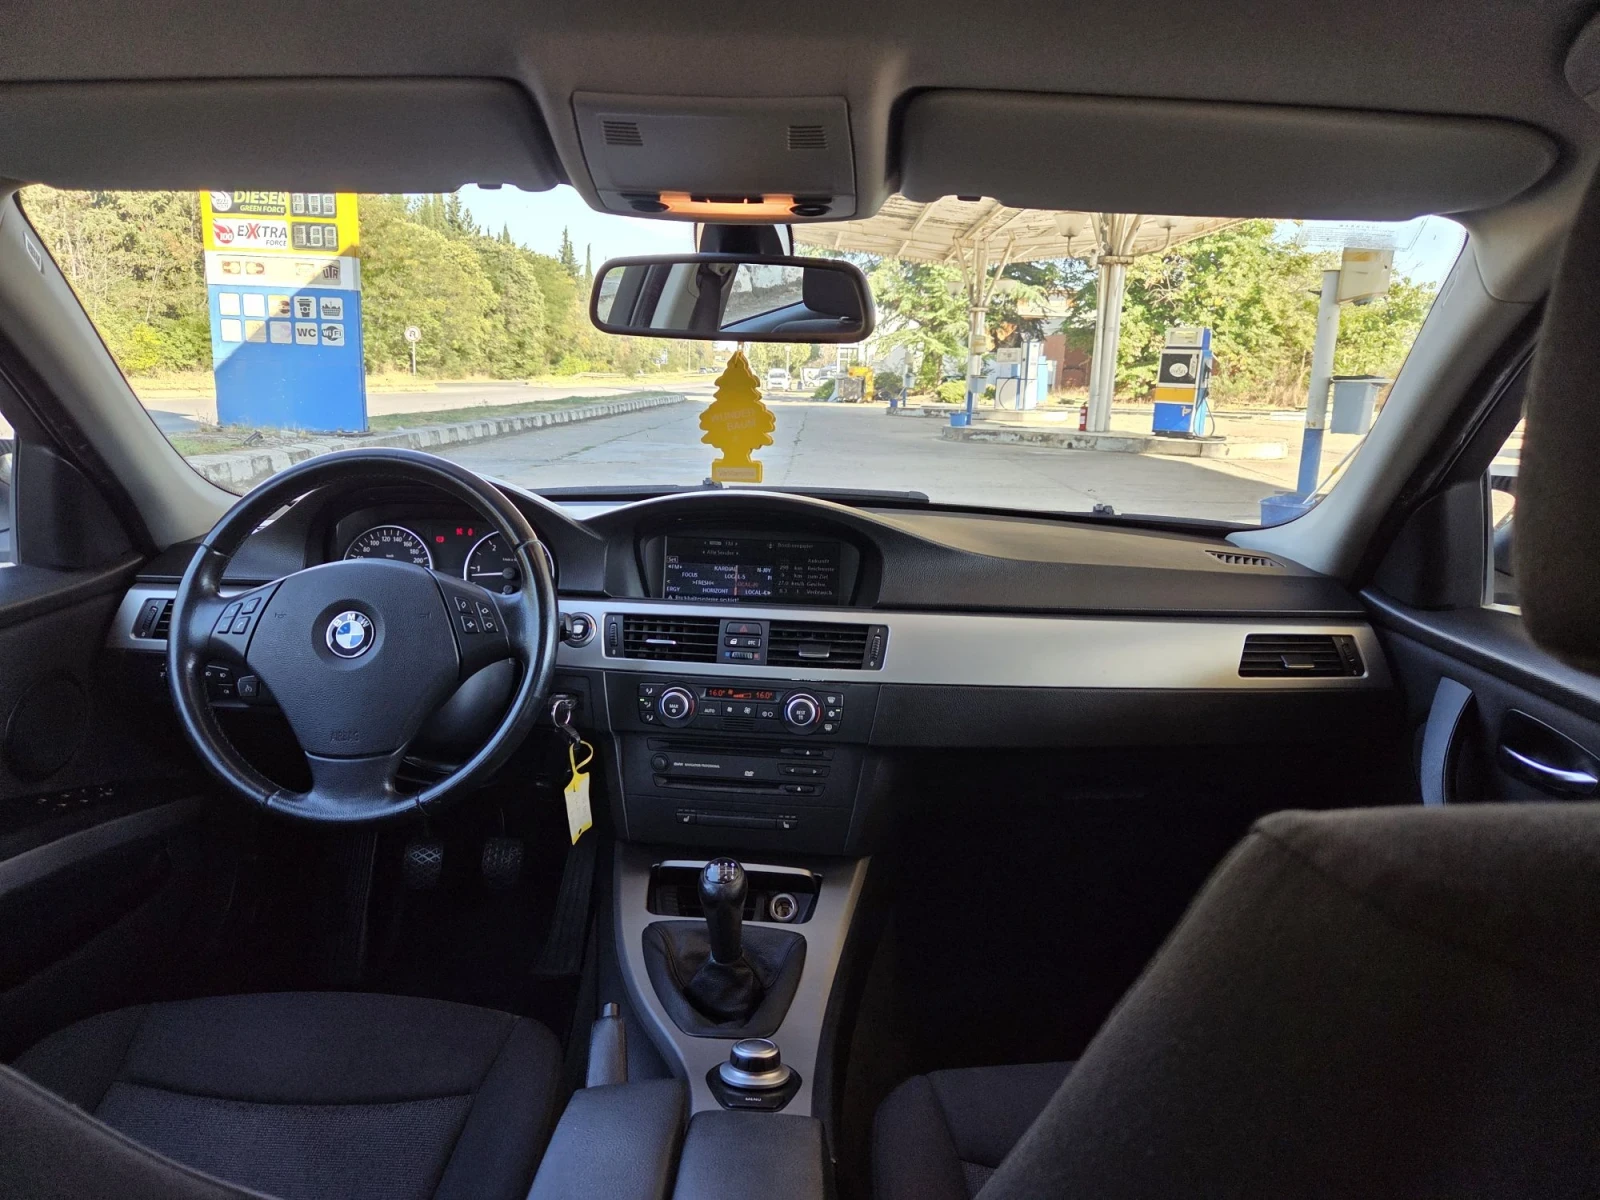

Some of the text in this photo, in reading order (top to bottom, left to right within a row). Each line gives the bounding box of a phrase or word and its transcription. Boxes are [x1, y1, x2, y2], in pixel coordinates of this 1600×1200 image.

[234, 191, 287, 205] DIESEL
[237, 223, 288, 239] EXTRA
[297, 328, 316, 338] WC
[333, 613, 370, 627] BMW
